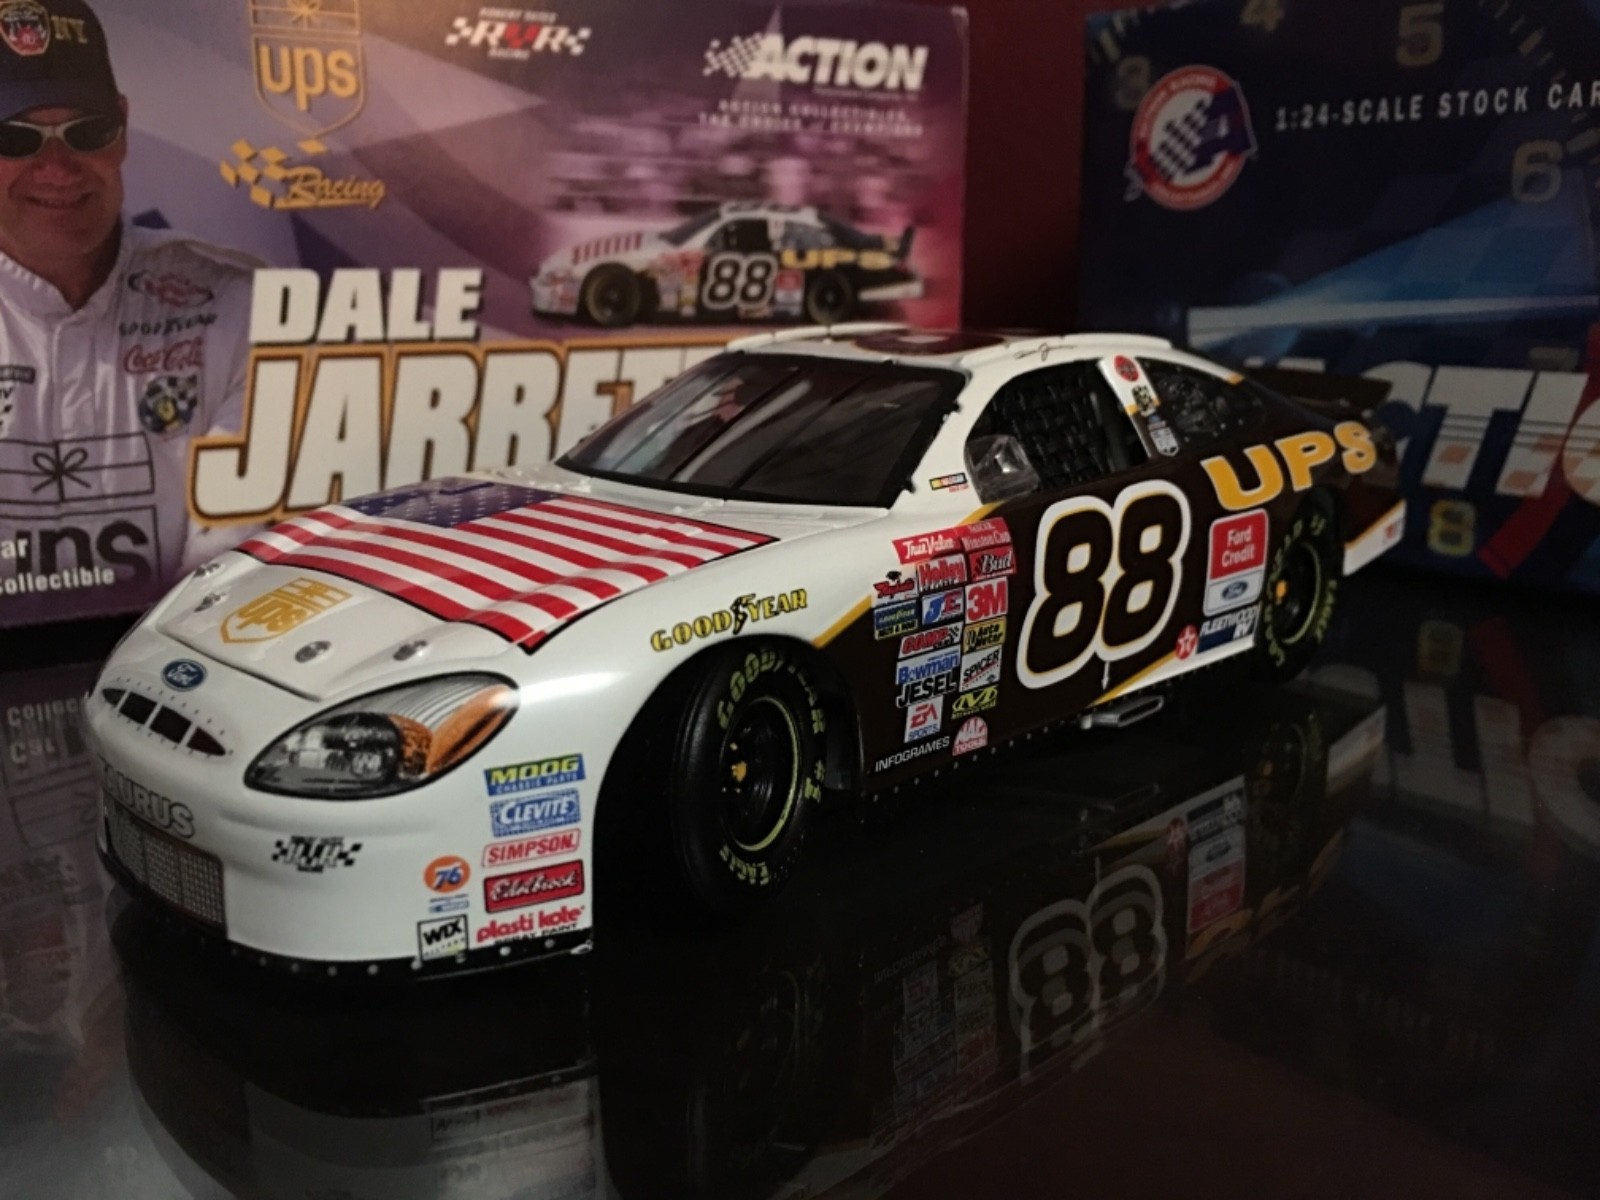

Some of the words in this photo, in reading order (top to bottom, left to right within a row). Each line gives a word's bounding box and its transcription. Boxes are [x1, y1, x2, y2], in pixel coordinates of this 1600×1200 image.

[1396, 0, 1444, 67] 5
[259, 45, 359, 112] ups
[742, 33, 929, 91] ACTION
[1275, 93, 1424, 132] 1:24-SCALE
[1437, 85, 1531, 119] STOCK
[287, 165, 386, 210] Racing
[1511, 140, 1563, 202] 6
[702, 252, 779, 310] 88
[249, 268, 483, 345] DALE
[186, 334, 733, 527] JARRET
[1200, 421, 1378, 511] UPS
[1226, 525, 1253, 548] Ford
[1426, 500, 1476, 557] 8
[1221, 543, 1256, 568] Credit
[0, 566, 116, 596] ollectible
[966, 580, 1008, 623] 3M
[1016, 479, 1192, 690] 88
[651, 588, 809, 653] GOODYEAR
[899, 655, 960, 684] Bowman
[963, 649, 1000, 677] SPICER
[897, 669, 959, 708] JESEL
[491, 757, 580, 786] MOOG
[874, 735, 951, 774] INFOGRAMES
[500, 796, 570, 825] CLEVITE
[488, 833, 576, 864] SIMPSON
[433, 863, 463, 891] 76
[423, 920, 464, 946] WIX
